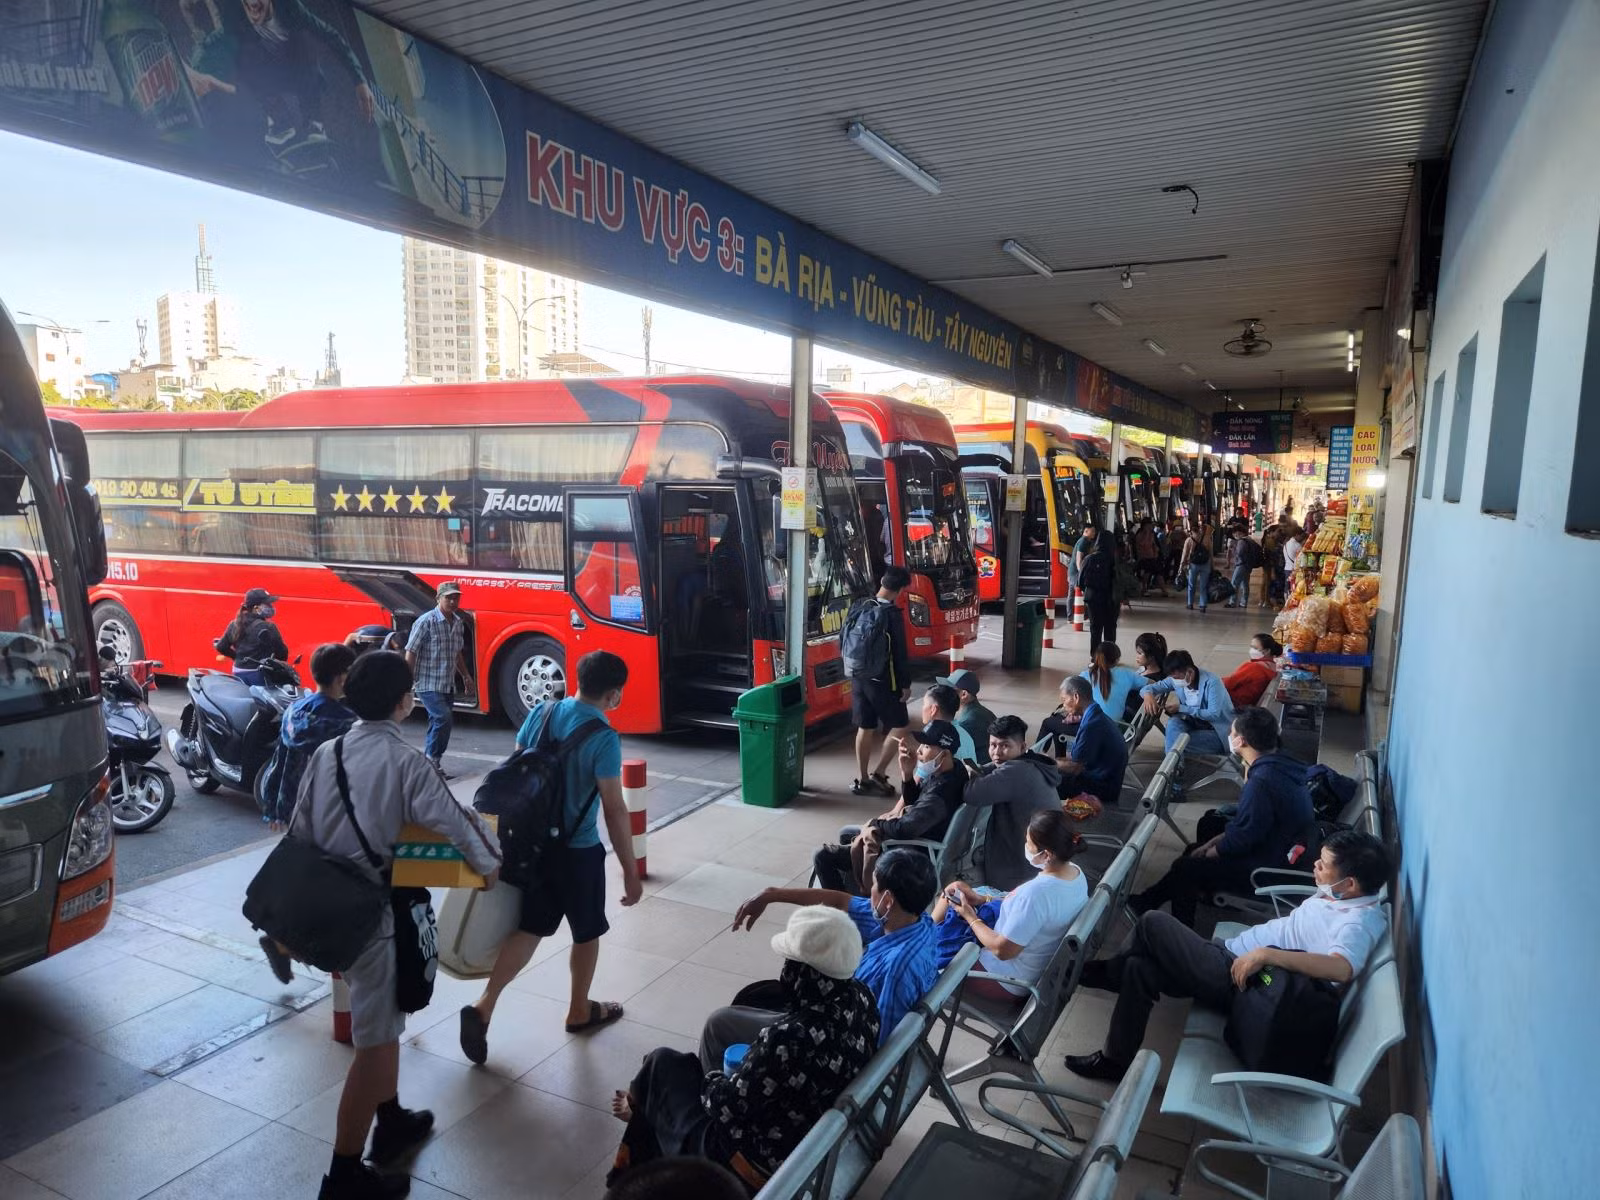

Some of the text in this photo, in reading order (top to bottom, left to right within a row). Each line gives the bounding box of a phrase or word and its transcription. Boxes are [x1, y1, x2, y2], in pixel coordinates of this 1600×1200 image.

[525, 130, 625, 231] KHU
[633, 177, 711, 264] VỰC
[717, 217, 745, 276] 3:
[755, 231, 791, 293] BÀ
[797, 255, 834, 312] RỊA
[852, 273, 902, 331] VŨNG
[906, 293, 935, 343] TÀU
[944, 311, 969, 354] TÂY
[969, 329, 1012, 370] NGUYÊN
[120, 480, 137, 497] 20
